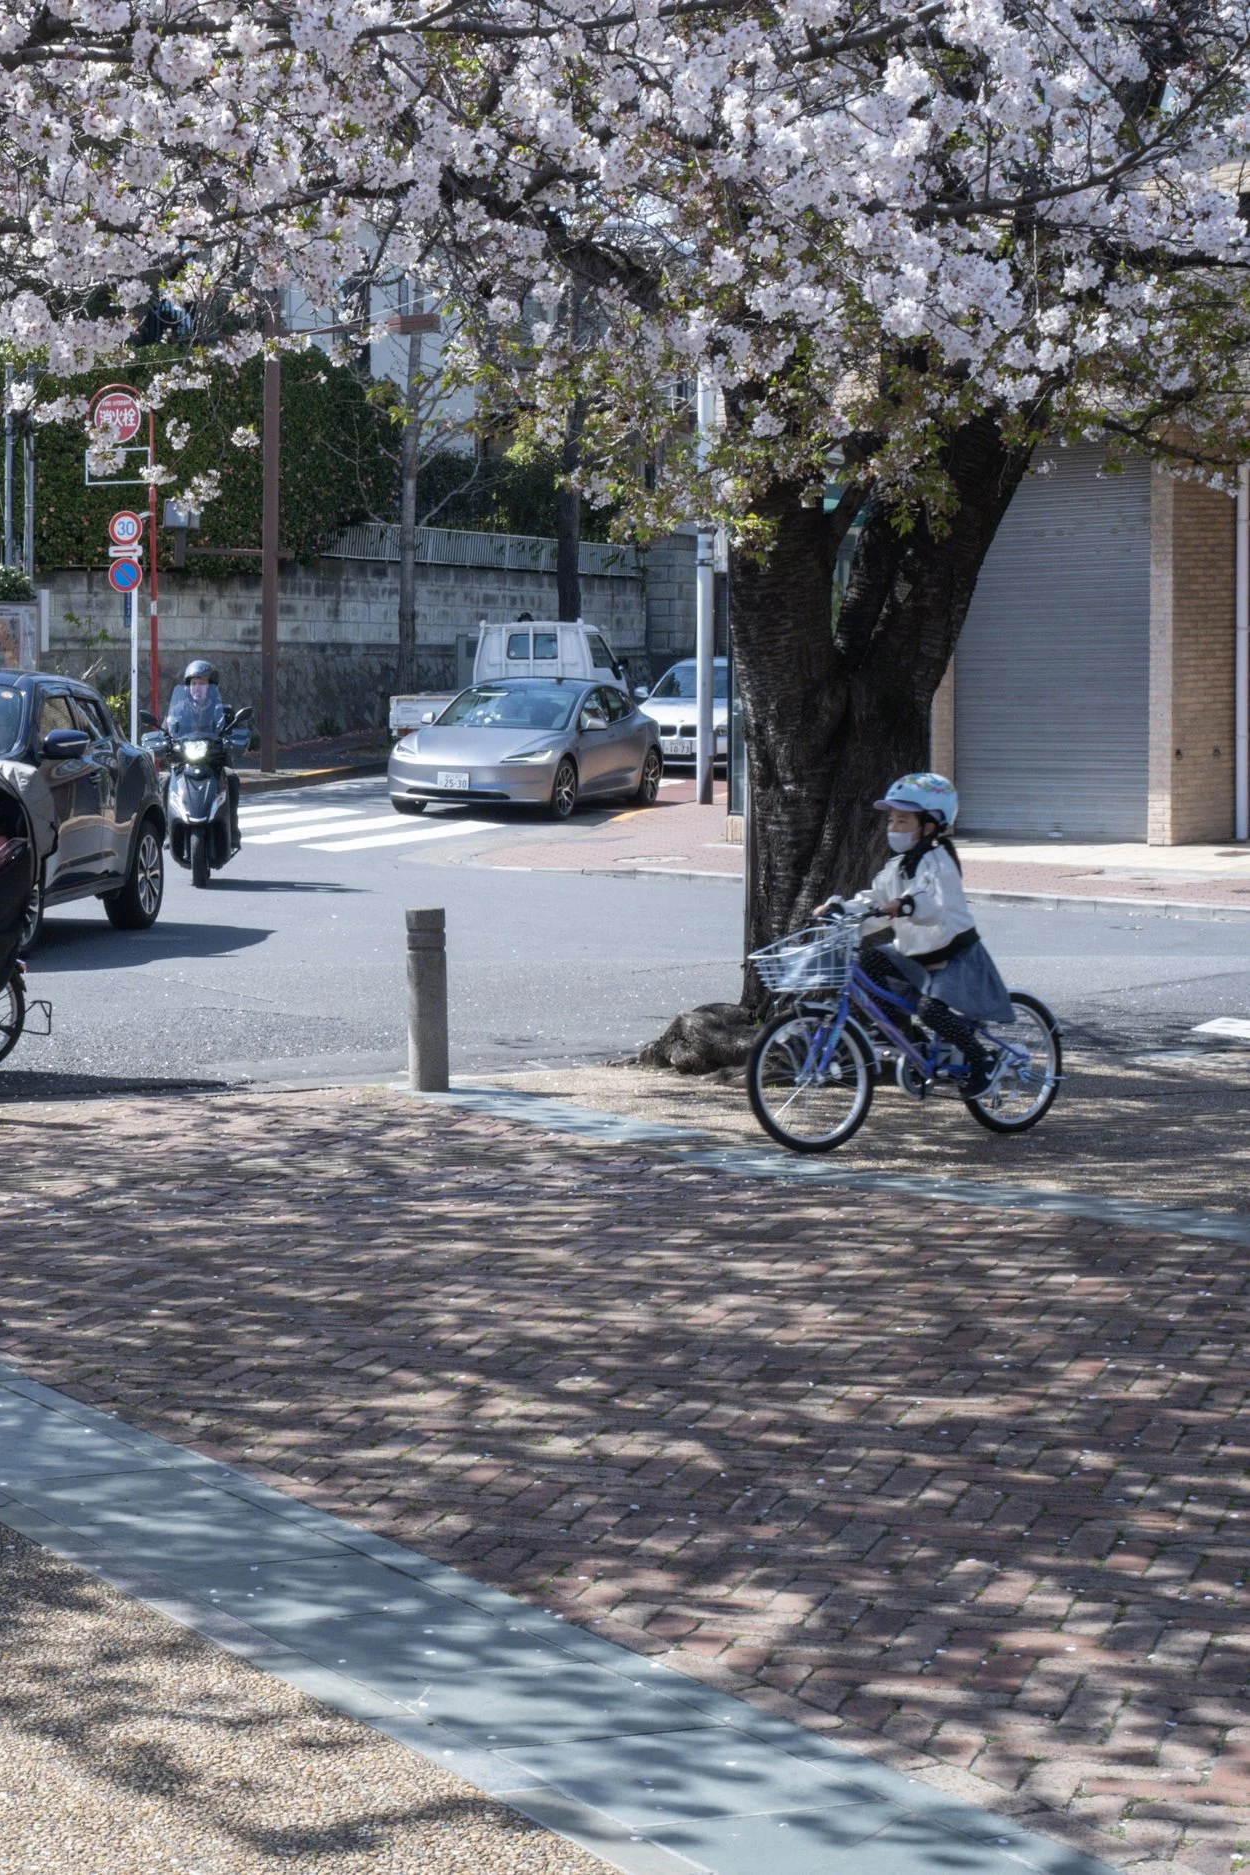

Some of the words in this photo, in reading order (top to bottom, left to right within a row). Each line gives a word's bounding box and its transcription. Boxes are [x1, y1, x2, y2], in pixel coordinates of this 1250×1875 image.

[100, 408, 137, 428] 消火栓
[117, 521, 135, 537] 30
